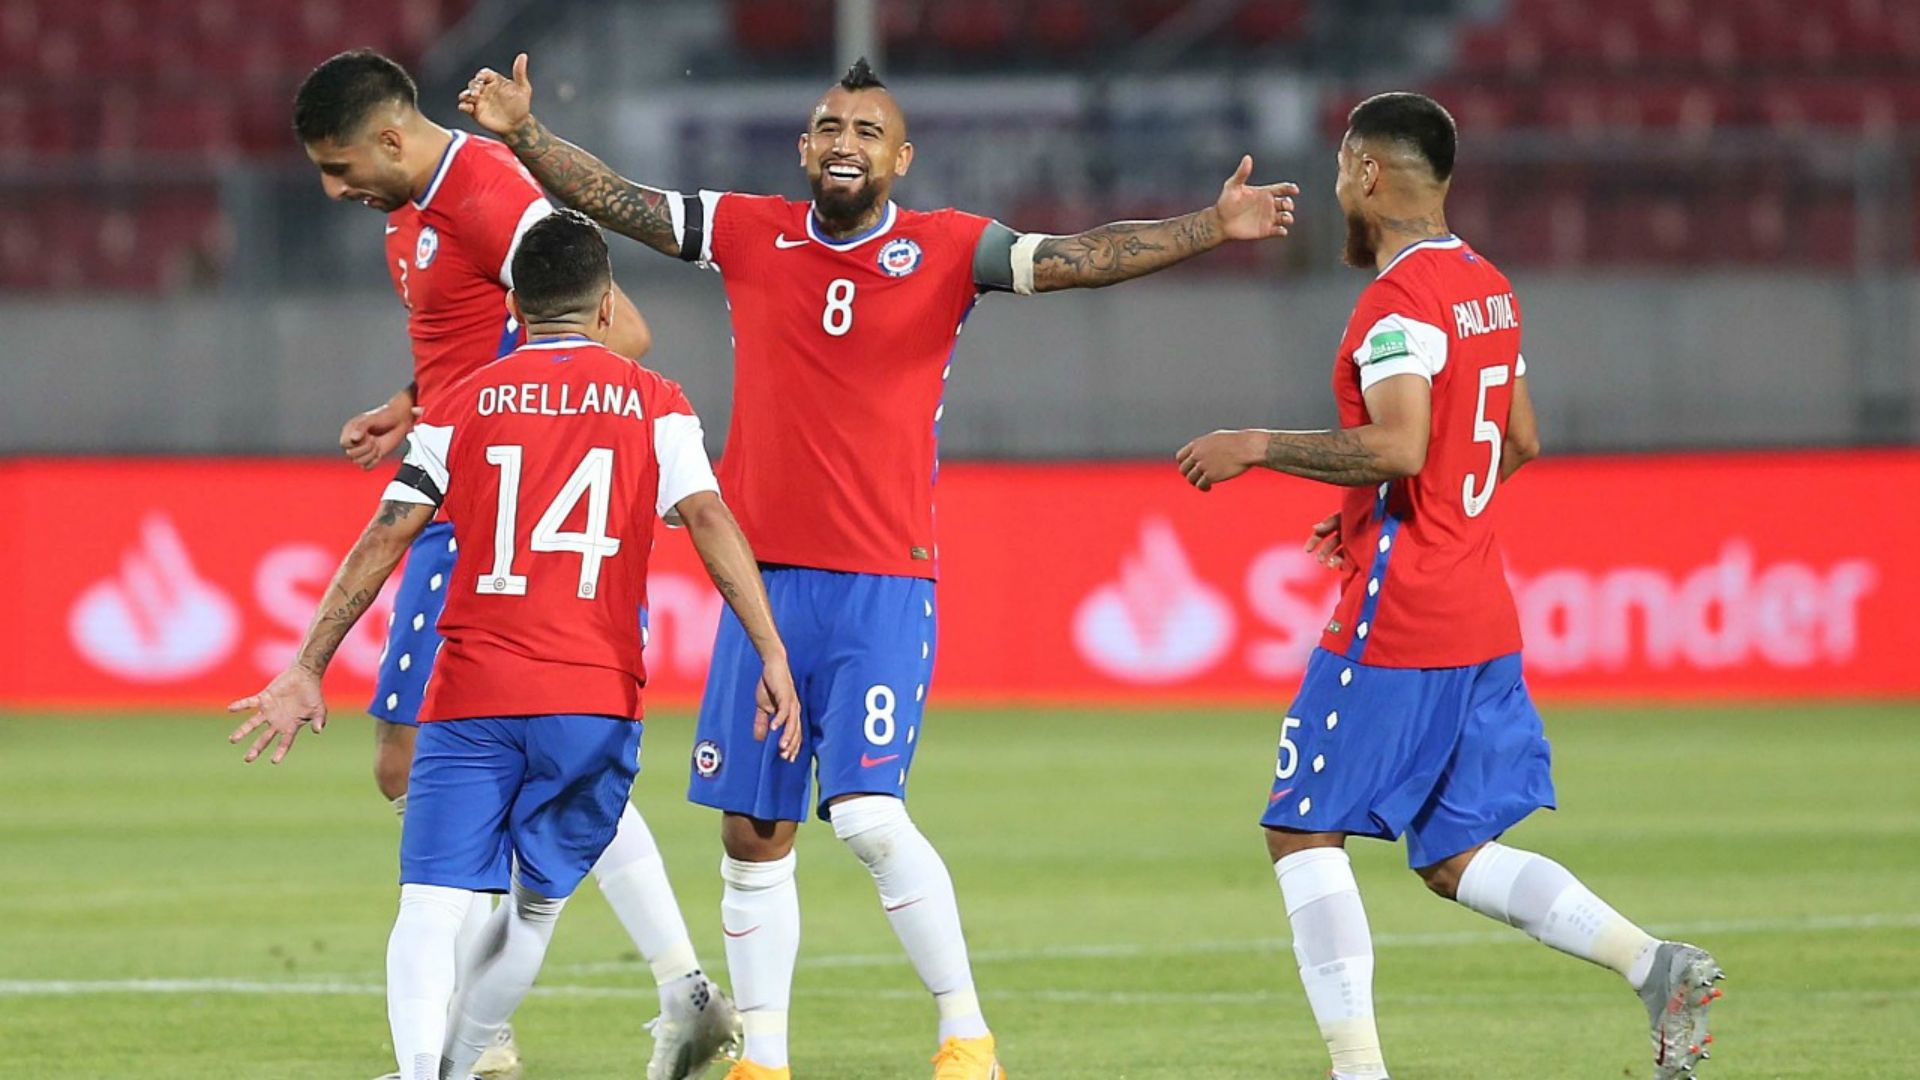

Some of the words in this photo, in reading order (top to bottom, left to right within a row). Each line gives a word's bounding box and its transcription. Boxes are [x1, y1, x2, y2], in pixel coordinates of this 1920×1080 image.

[823, 278, 855, 336] 8
[477, 382, 643, 420] ORELLANA
[1462, 364, 1509, 518] 5
[475, 444, 621, 600] 14
[1246, 540, 1873, 675] Sander
[863, 684, 895, 746] 8
[1275, 716, 1301, 779] 5
